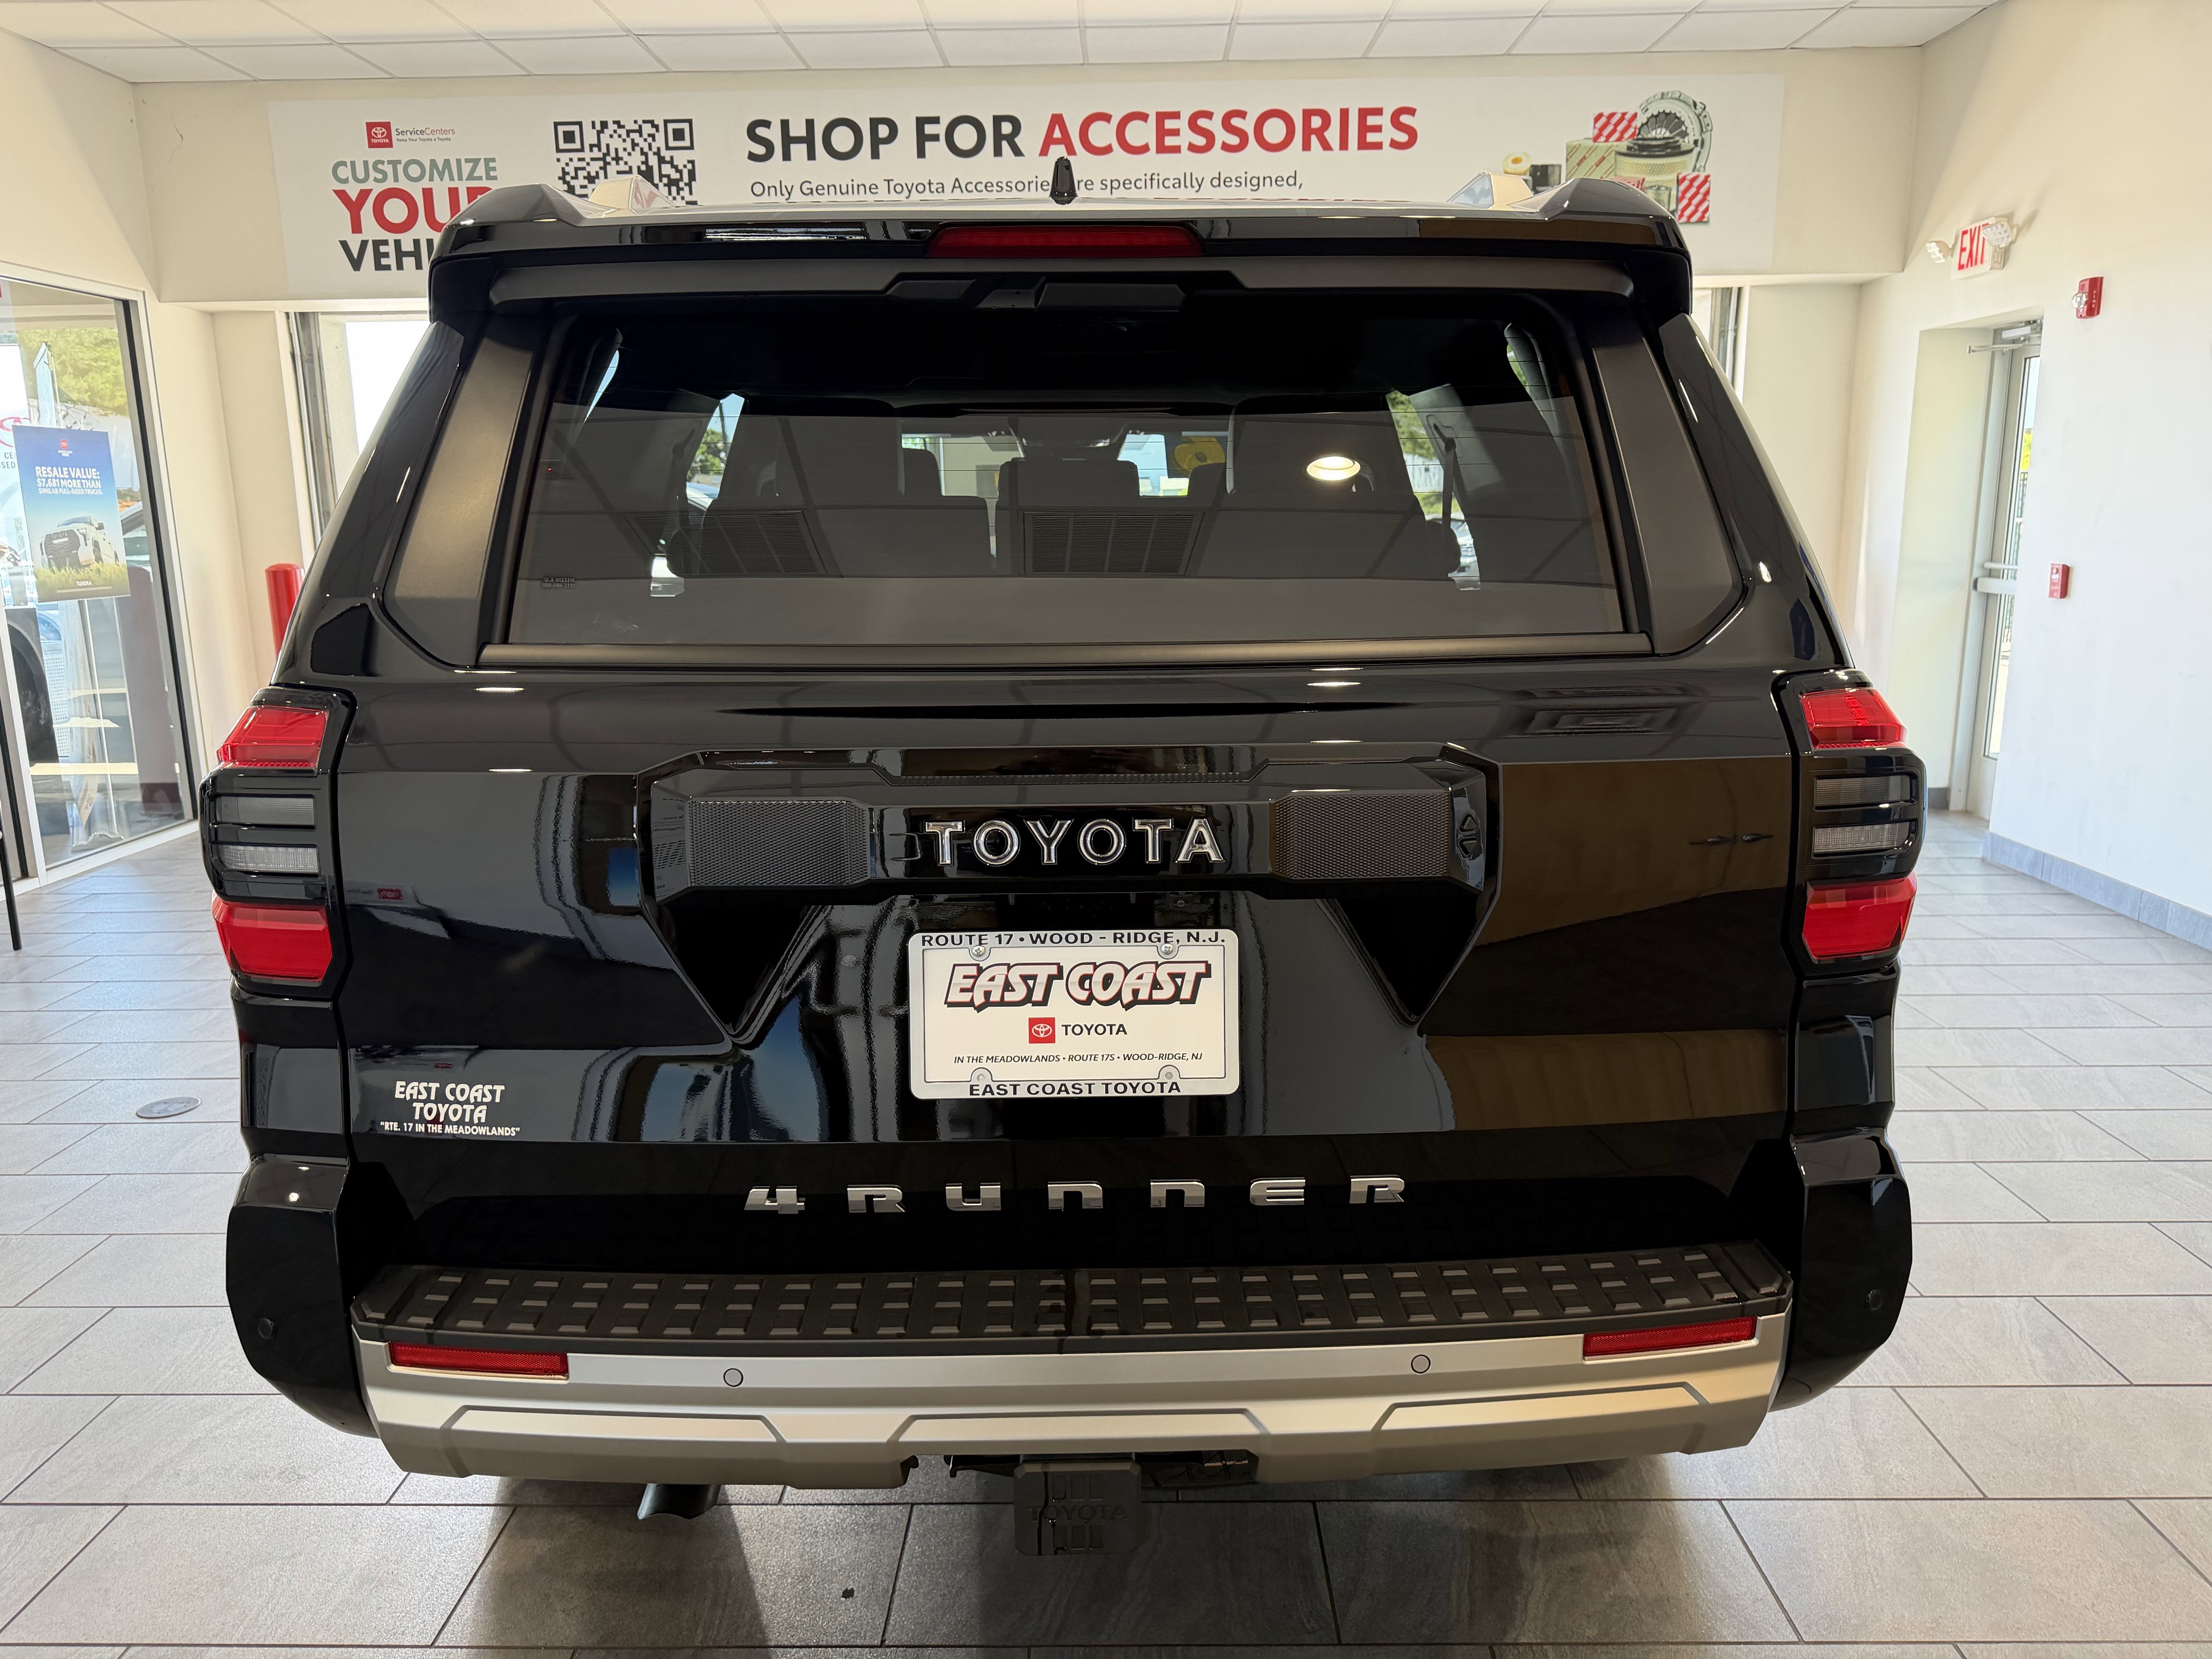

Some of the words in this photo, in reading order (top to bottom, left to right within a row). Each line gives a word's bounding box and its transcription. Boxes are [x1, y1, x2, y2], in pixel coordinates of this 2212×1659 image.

[746, 117, 898, 163] SHOP
[916, 115, 1025, 159] FOR
[1039, 106, 1418, 157] ACCESSORIES
[331, 158, 498, 184] CUSTOMIZE
[750, 180, 794, 200] Only
[800, 179, 879, 196] Genuine
[883, 178, 945, 199] Toyota
[951, 175, 1050, 193] Accessorie
[1100, 172, 1204, 193] specifically
[1210, 170, 1303, 192] designed,
[1958, 223, 1989, 270] EXIT
[35, 466, 69, 478] RESALE
[69, 467, 100, 479] VALUE:
[37, 477, 60, 487] $7,681
[60, 479, 81, 488] MORE
[81, 480, 101, 488] THAN
[925, 817, 1225, 867] TOYOTA
[922, 934, 988, 946] ROUTE
[995, 934, 1012, 944] 17
[1030, 933, 1093, 944] WOOD
[1113, 932, 1180, 944] RIDGE,
[1187, 931, 1225, 943] N.J.
[944, 963, 1063, 1013] EAST
[1066, 960, 1212, 1011] COAST
[1061, 1024, 1127, 1036] TOYOTA
[965, 1055, 984, 1063] THE
[986, 1054, 1060, 1063] MEADOWLANDS
[1123, 1053, 1189, 1061] WOOD-RIDGE,
[395, 1081, 440, 1101] EAST
[445, 1083, 505, 1103] COAST
[969, 1082, 1020, 1096] EAST
[1026, 1083, 1095, 1095] COAST
[1104, 1082, 1181, 1094] TOYOTA
[412, 1102, 487, 1124] TOYOTA
[404, 1123, 413, 1132] 17
[416, 1123, 425, 1133] IN
[427, 1124, 442, 1133] THE
[744, 1175, 1405, 1214] 4RUNNER
[1027, 1504, 1128, 1522] TOYOTA
